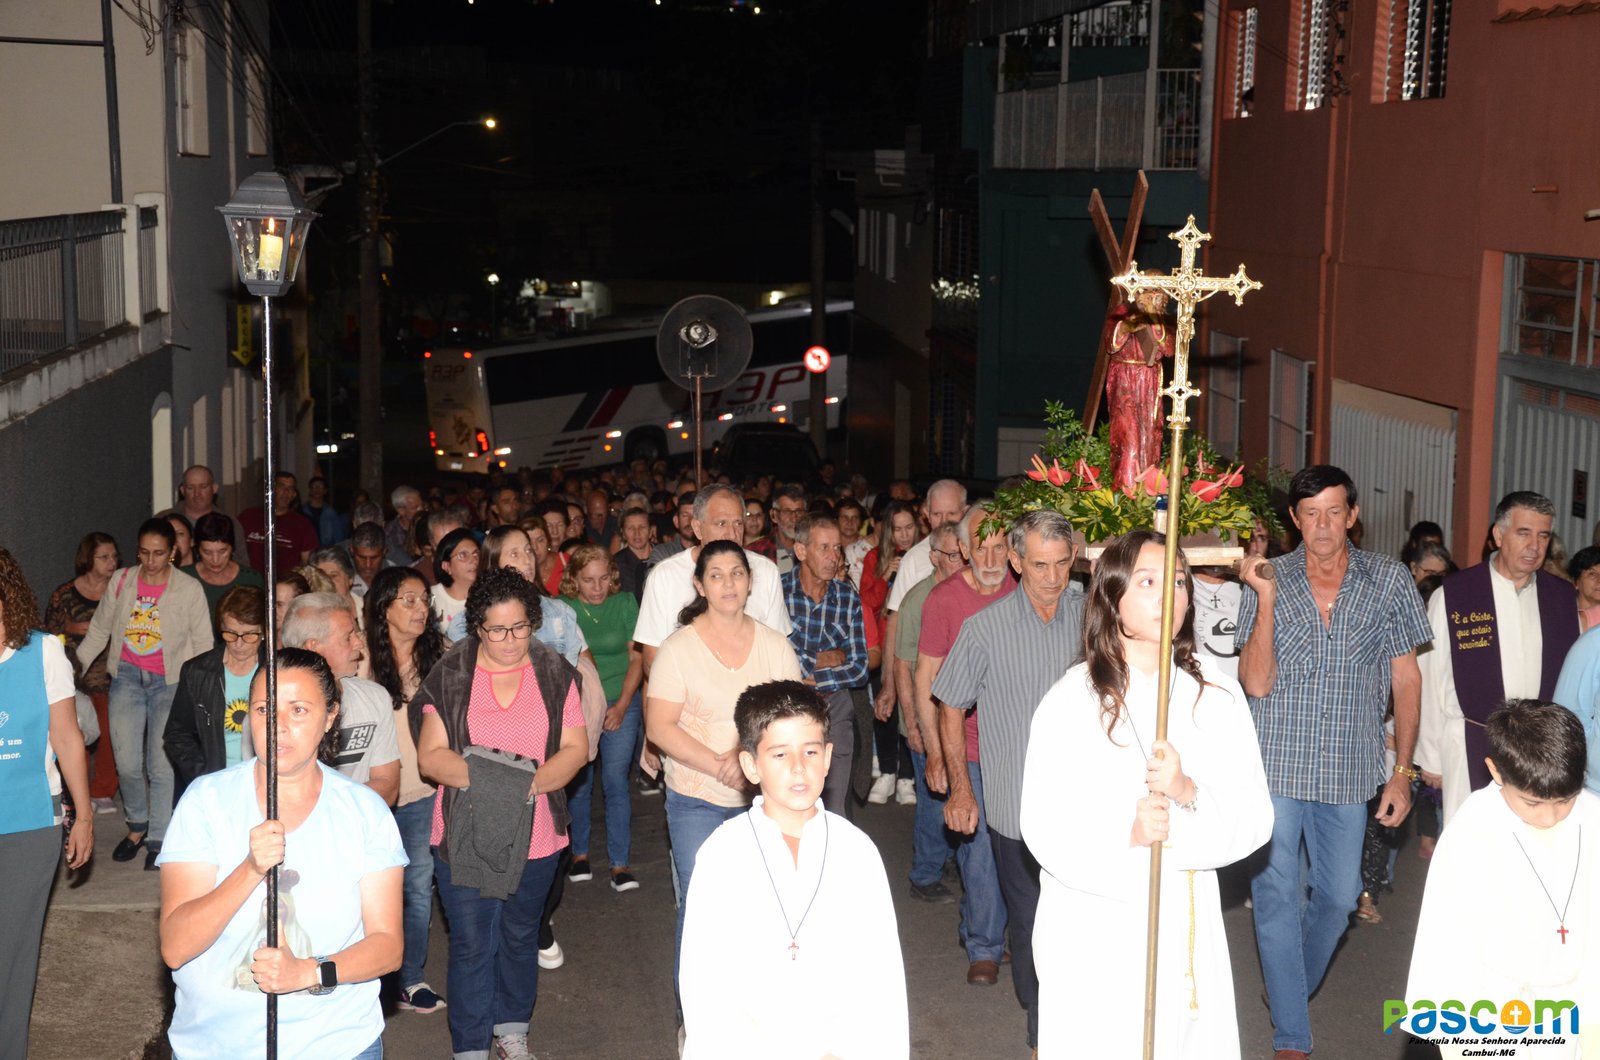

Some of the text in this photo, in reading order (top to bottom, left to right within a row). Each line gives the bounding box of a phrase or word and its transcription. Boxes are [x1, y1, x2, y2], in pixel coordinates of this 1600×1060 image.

[1456, 630, 1470, 640] que
[353, 726, 369, 739] FH
[0, 752, 21, 761] mor.
